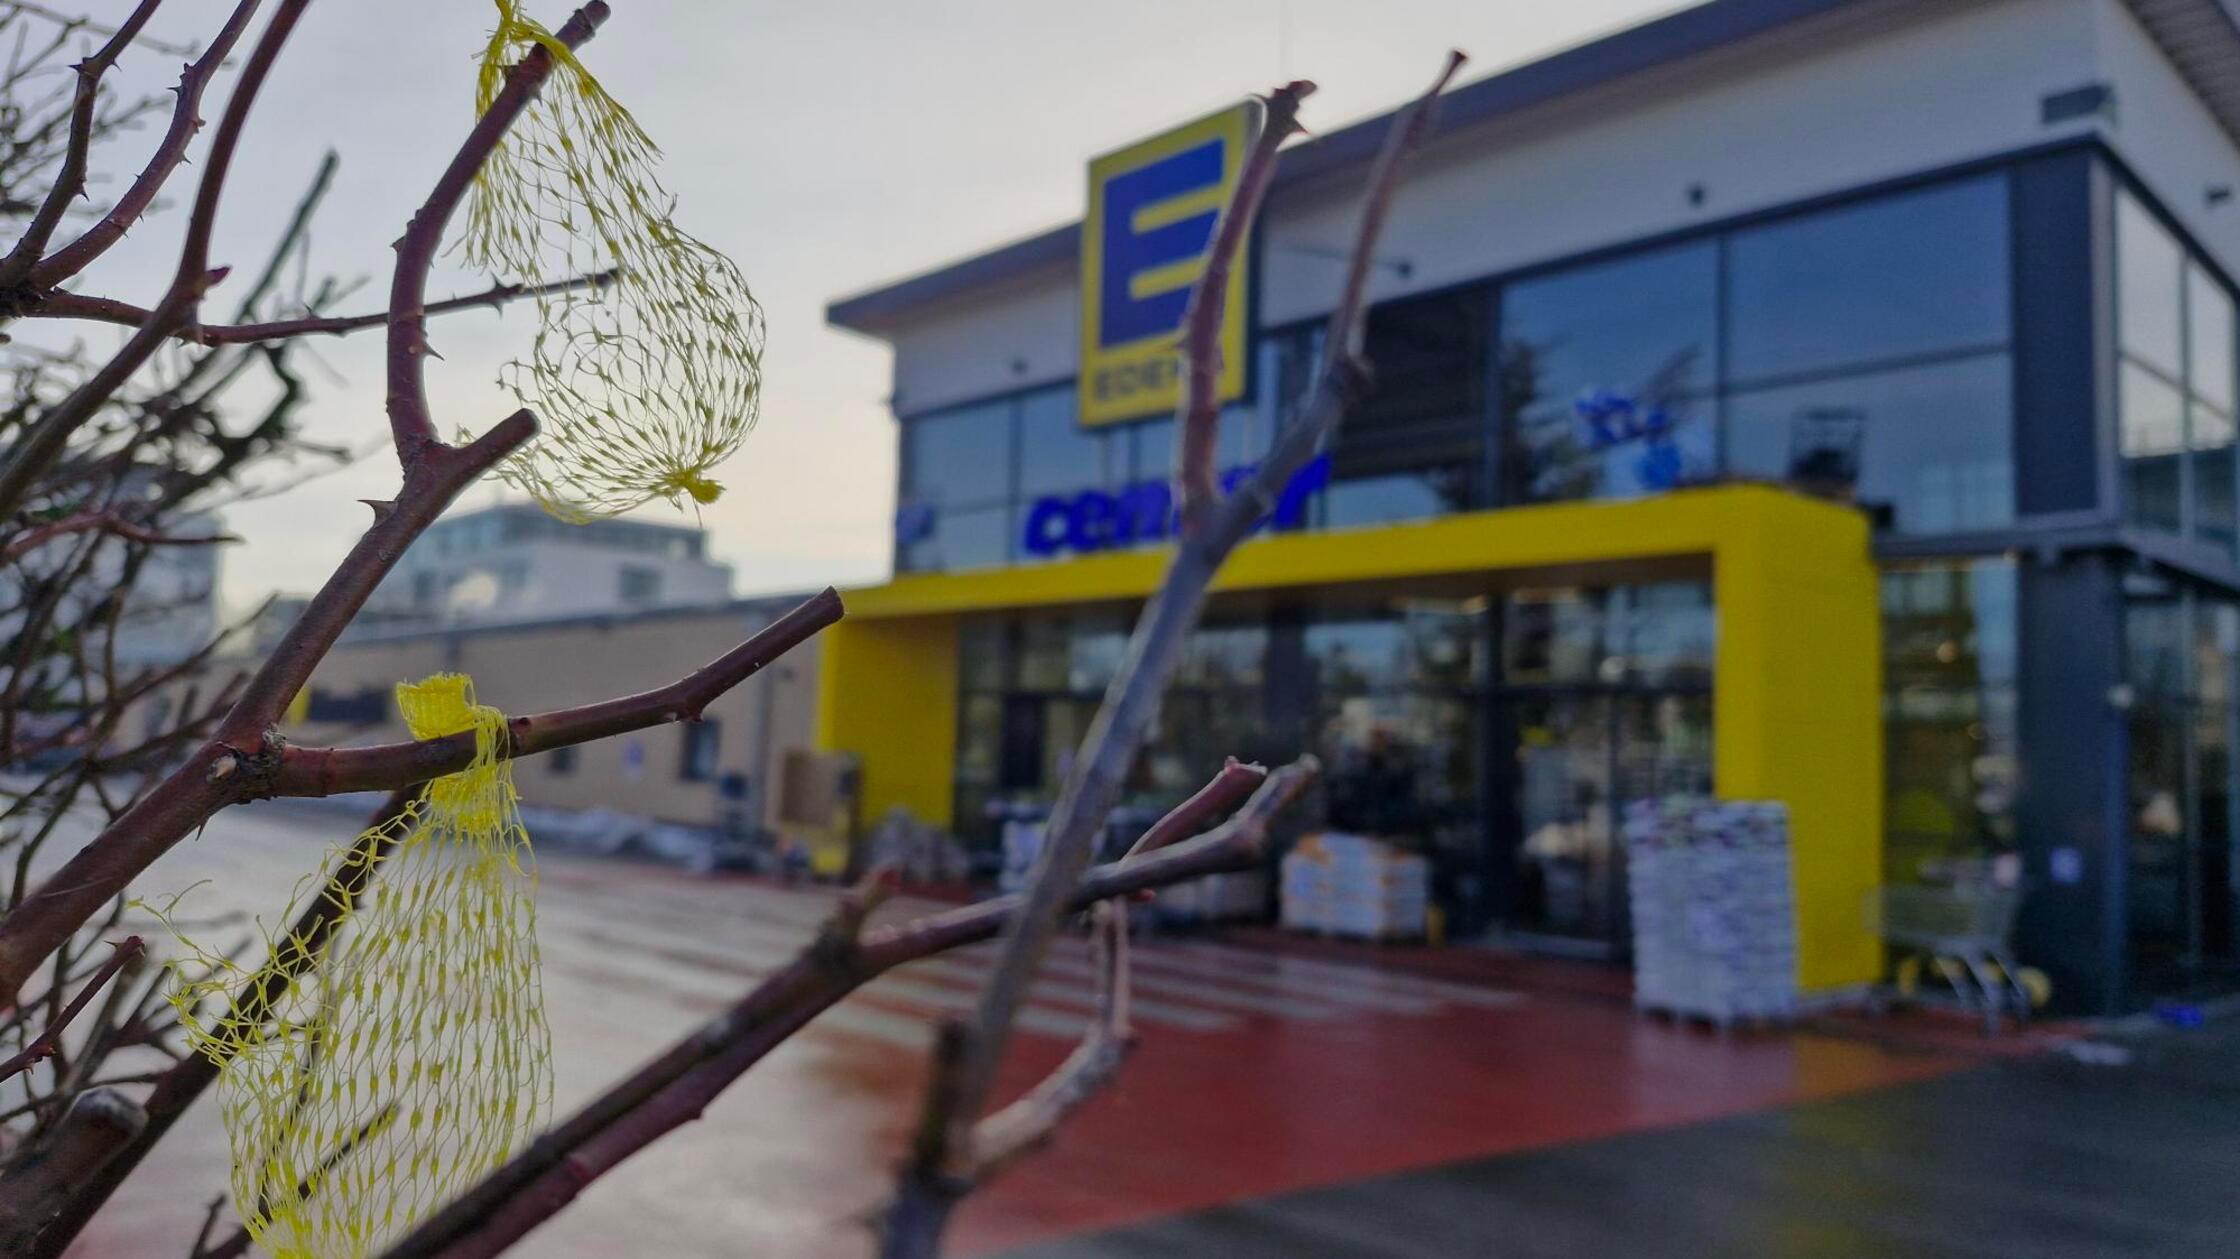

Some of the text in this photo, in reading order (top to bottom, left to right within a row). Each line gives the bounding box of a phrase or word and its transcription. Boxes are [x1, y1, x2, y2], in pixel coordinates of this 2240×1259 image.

[1100, 137, 1227, 348] E
[1094, 353, 1190, 401] EDE
[1024, 452, 1333, 556] cenr
